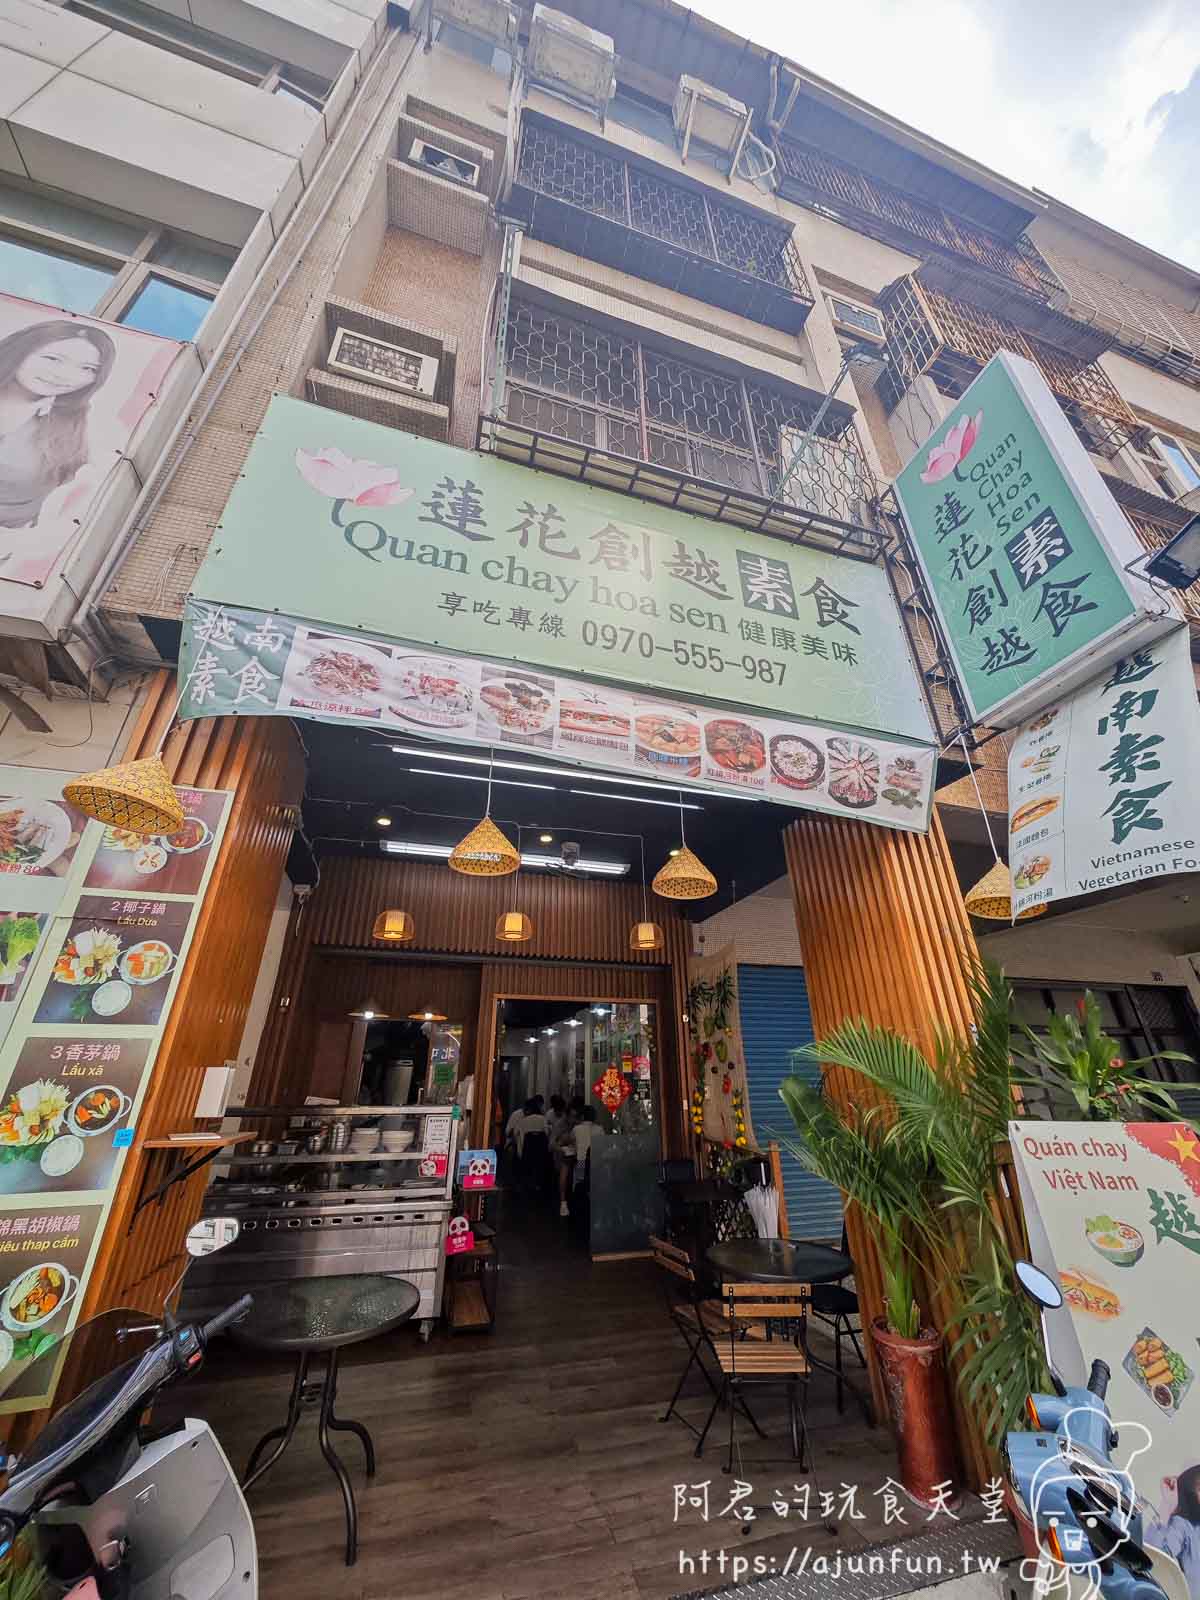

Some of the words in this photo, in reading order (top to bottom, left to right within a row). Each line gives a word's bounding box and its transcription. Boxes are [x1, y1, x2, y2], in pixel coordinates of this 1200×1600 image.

[970, 432, 1017, 482] Quan
[978, 449, 1022, 499] Chay
[986, 471, 1033, 519] Hoa
[996, 492, 1041, 537] Sen
[343, 520, 471, 575] Quan
[480, 555, 580, 604] chay
[589, 574, 660, 618] hoa
[668, 602, 729, 635] sen
[933, 491, 1038, 677] 蓮花創越
[1008, 514, 1099, 639] 素食
[437, 591, 567, 640] 享吃專線
[581, 619, 788, 688] 0970-555-987
[737, 616, 860, 667] 健康美味
[187, 652, 282, 705] 素食
[1078, 862, 1167, 891] Vegetarian
[1172, 858, 1200, 871] Fo
[1090, 839, 1196, 869] Vietnamese
[1023, 1133, 1079, 1161] Quán
[1081, 1136, 1128, 1162] chay
[1042, 1168, 1088, 1197] Việt
[1088, 1170, 1139, 1191] Nam
